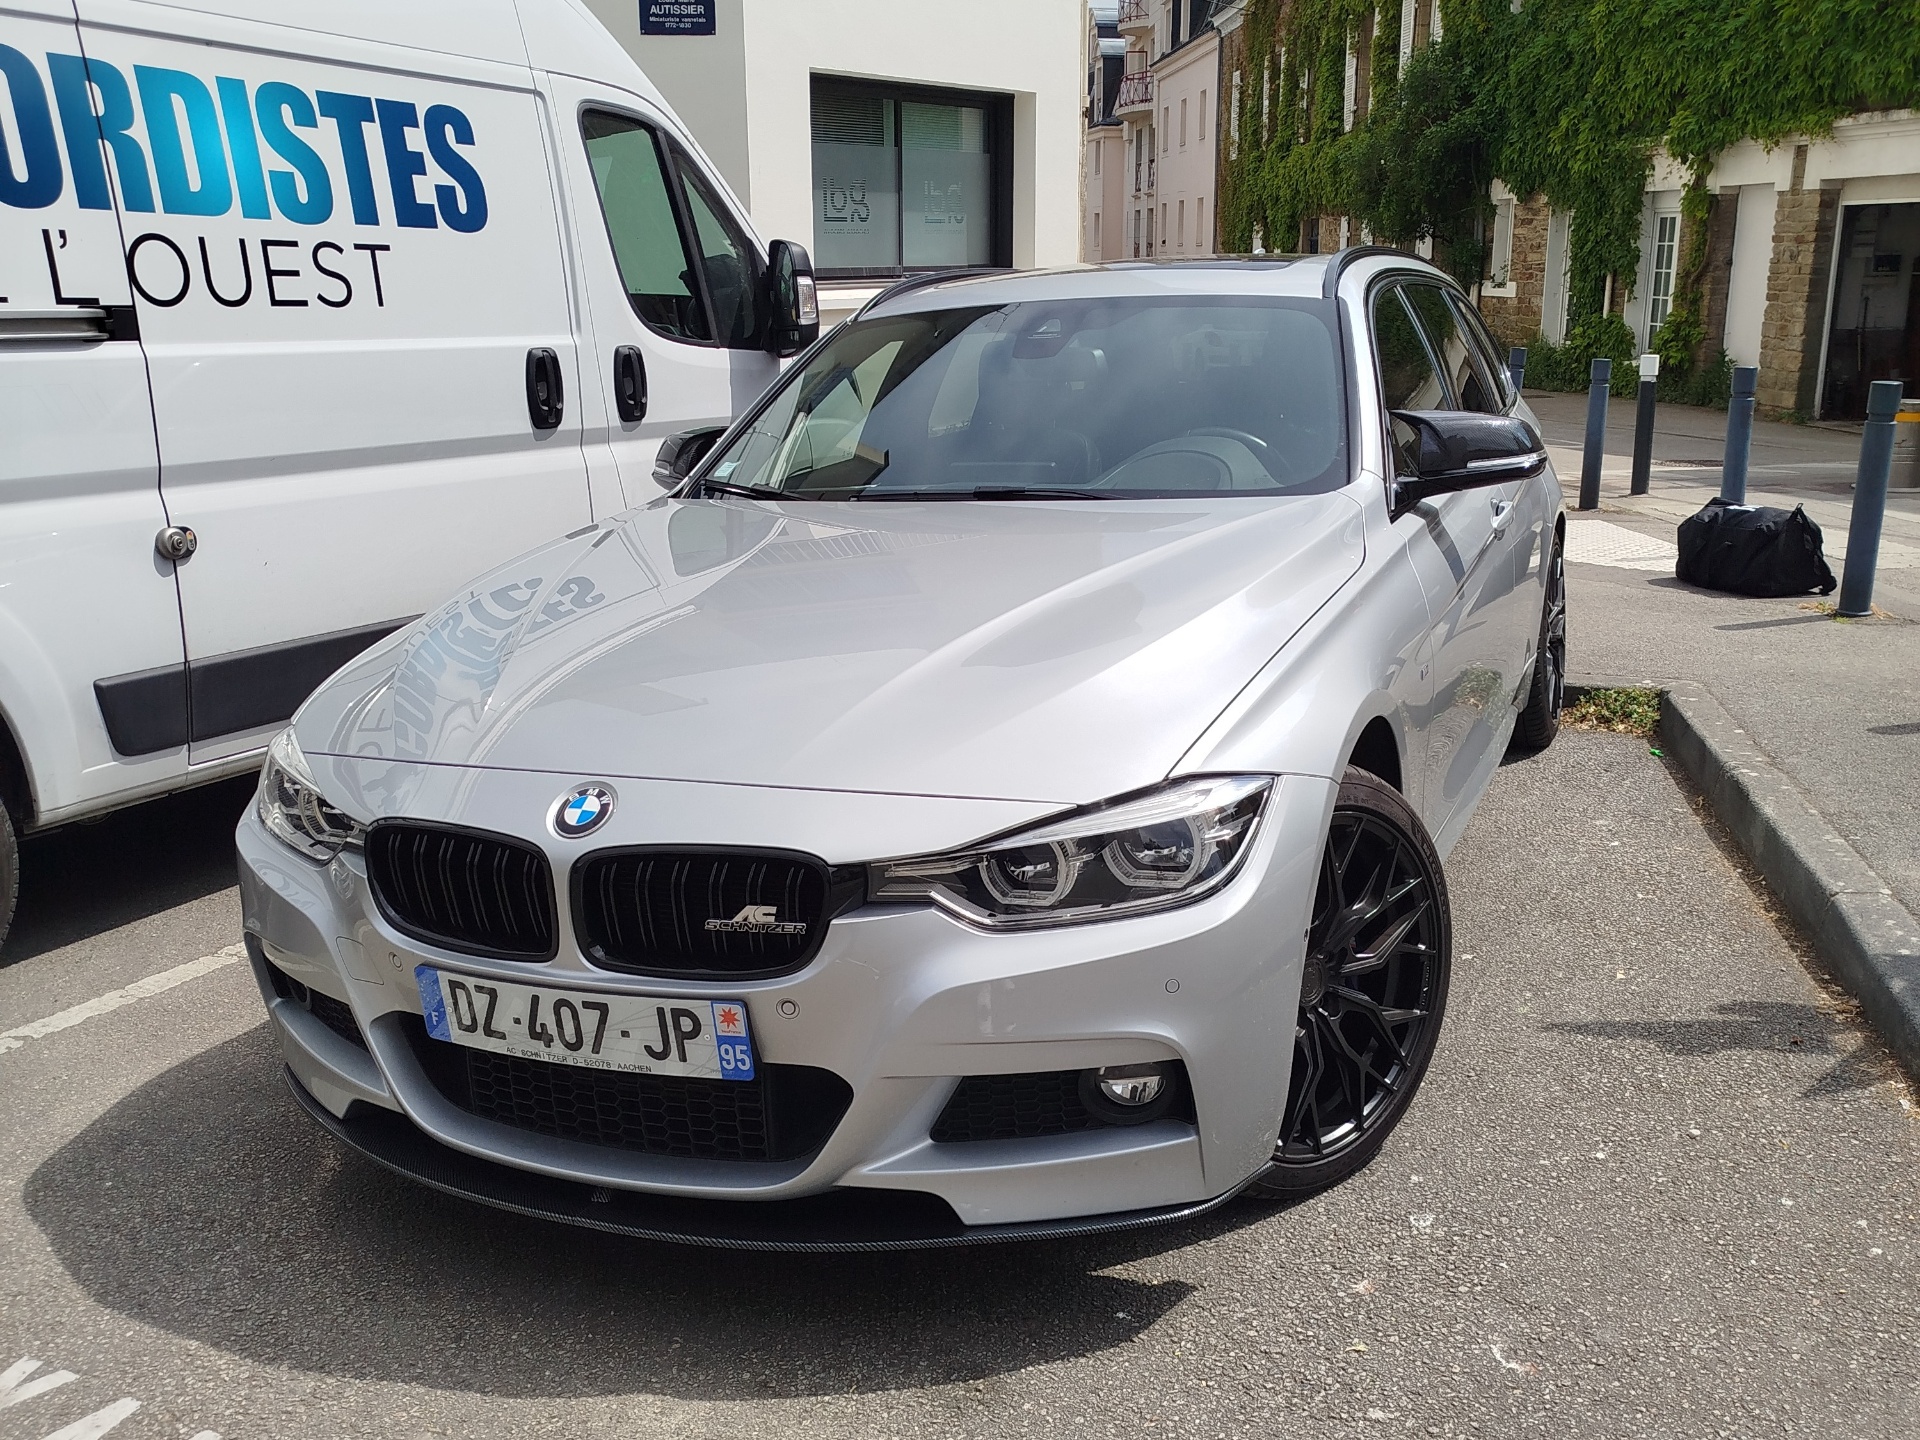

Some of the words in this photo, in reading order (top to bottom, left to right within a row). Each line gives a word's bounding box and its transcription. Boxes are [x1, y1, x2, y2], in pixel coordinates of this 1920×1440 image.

[650, 5, 705, 14] AUTISSIER
[568, 788, 612, 805] BMW
[731, 904, 777, 923] AC
[704, 919, 807, 935] SCHNITZER
[431, 1011, 439, 1026] F
[506, 1046, 517, 1055] AC
[520, 1049, 568, 1063] SCHNITZER
[572, 1057, 612, 1069] D-52078
[617, 1063, 652, 1073] AACHEN
[719, 1043, 751, 1071] 95
